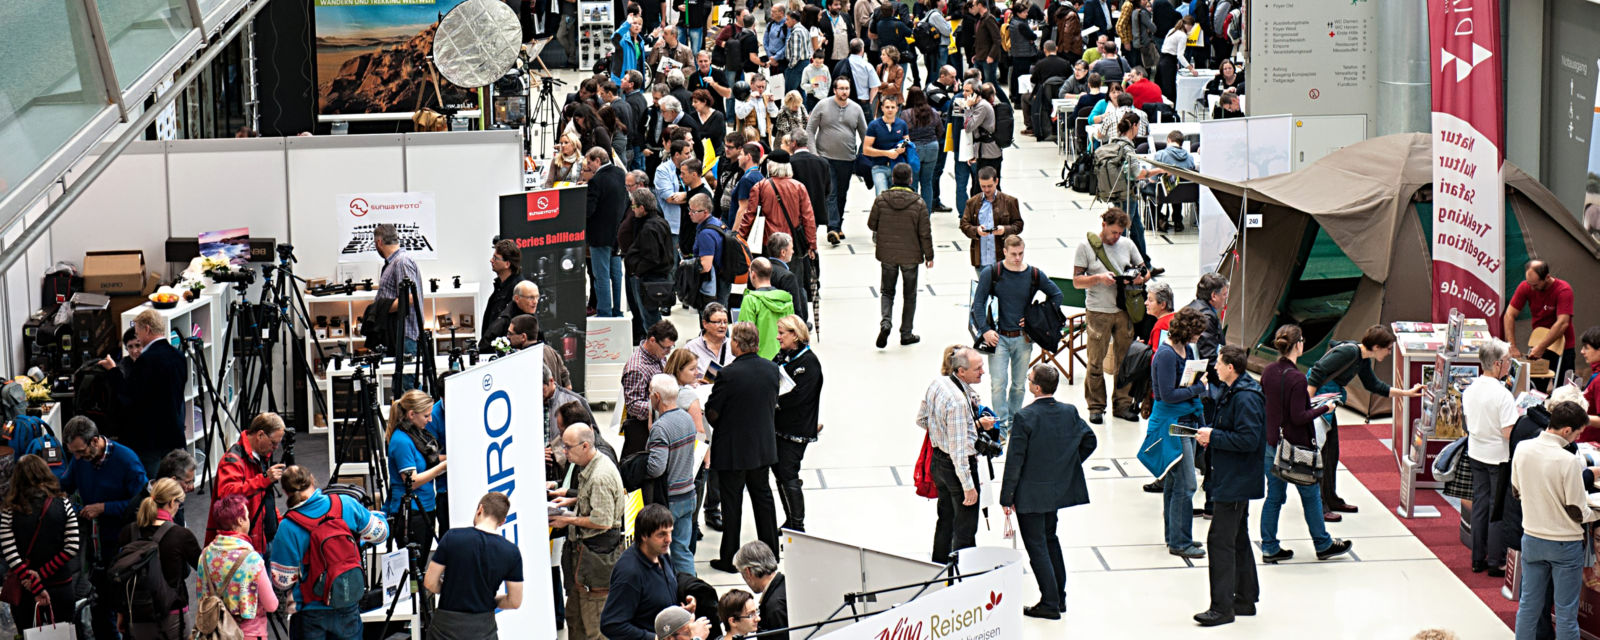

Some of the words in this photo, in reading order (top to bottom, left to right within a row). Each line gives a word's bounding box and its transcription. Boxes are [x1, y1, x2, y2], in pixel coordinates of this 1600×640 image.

[515, 235, 545, 249] Series
[545, 229, 585, 245] BallHead
[930, 606, 983, 640] Reisen
